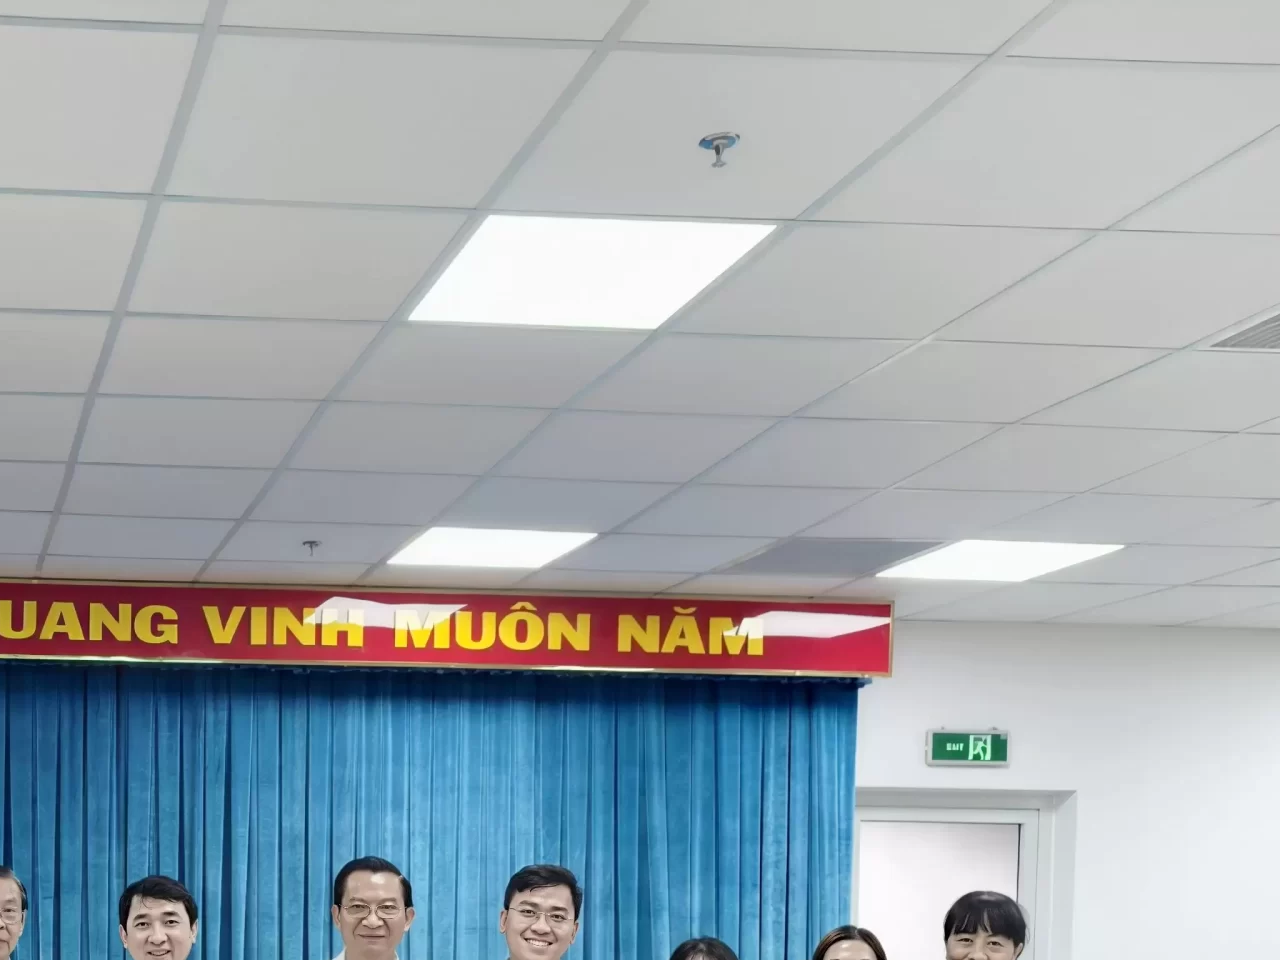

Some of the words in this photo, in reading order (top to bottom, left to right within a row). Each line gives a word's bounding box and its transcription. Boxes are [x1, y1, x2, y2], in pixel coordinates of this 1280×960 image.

[202, 606, 365, 649] VINH
[394, 602, 591, 651] MUÔN
[617, 607, 764, 656] NĂM
